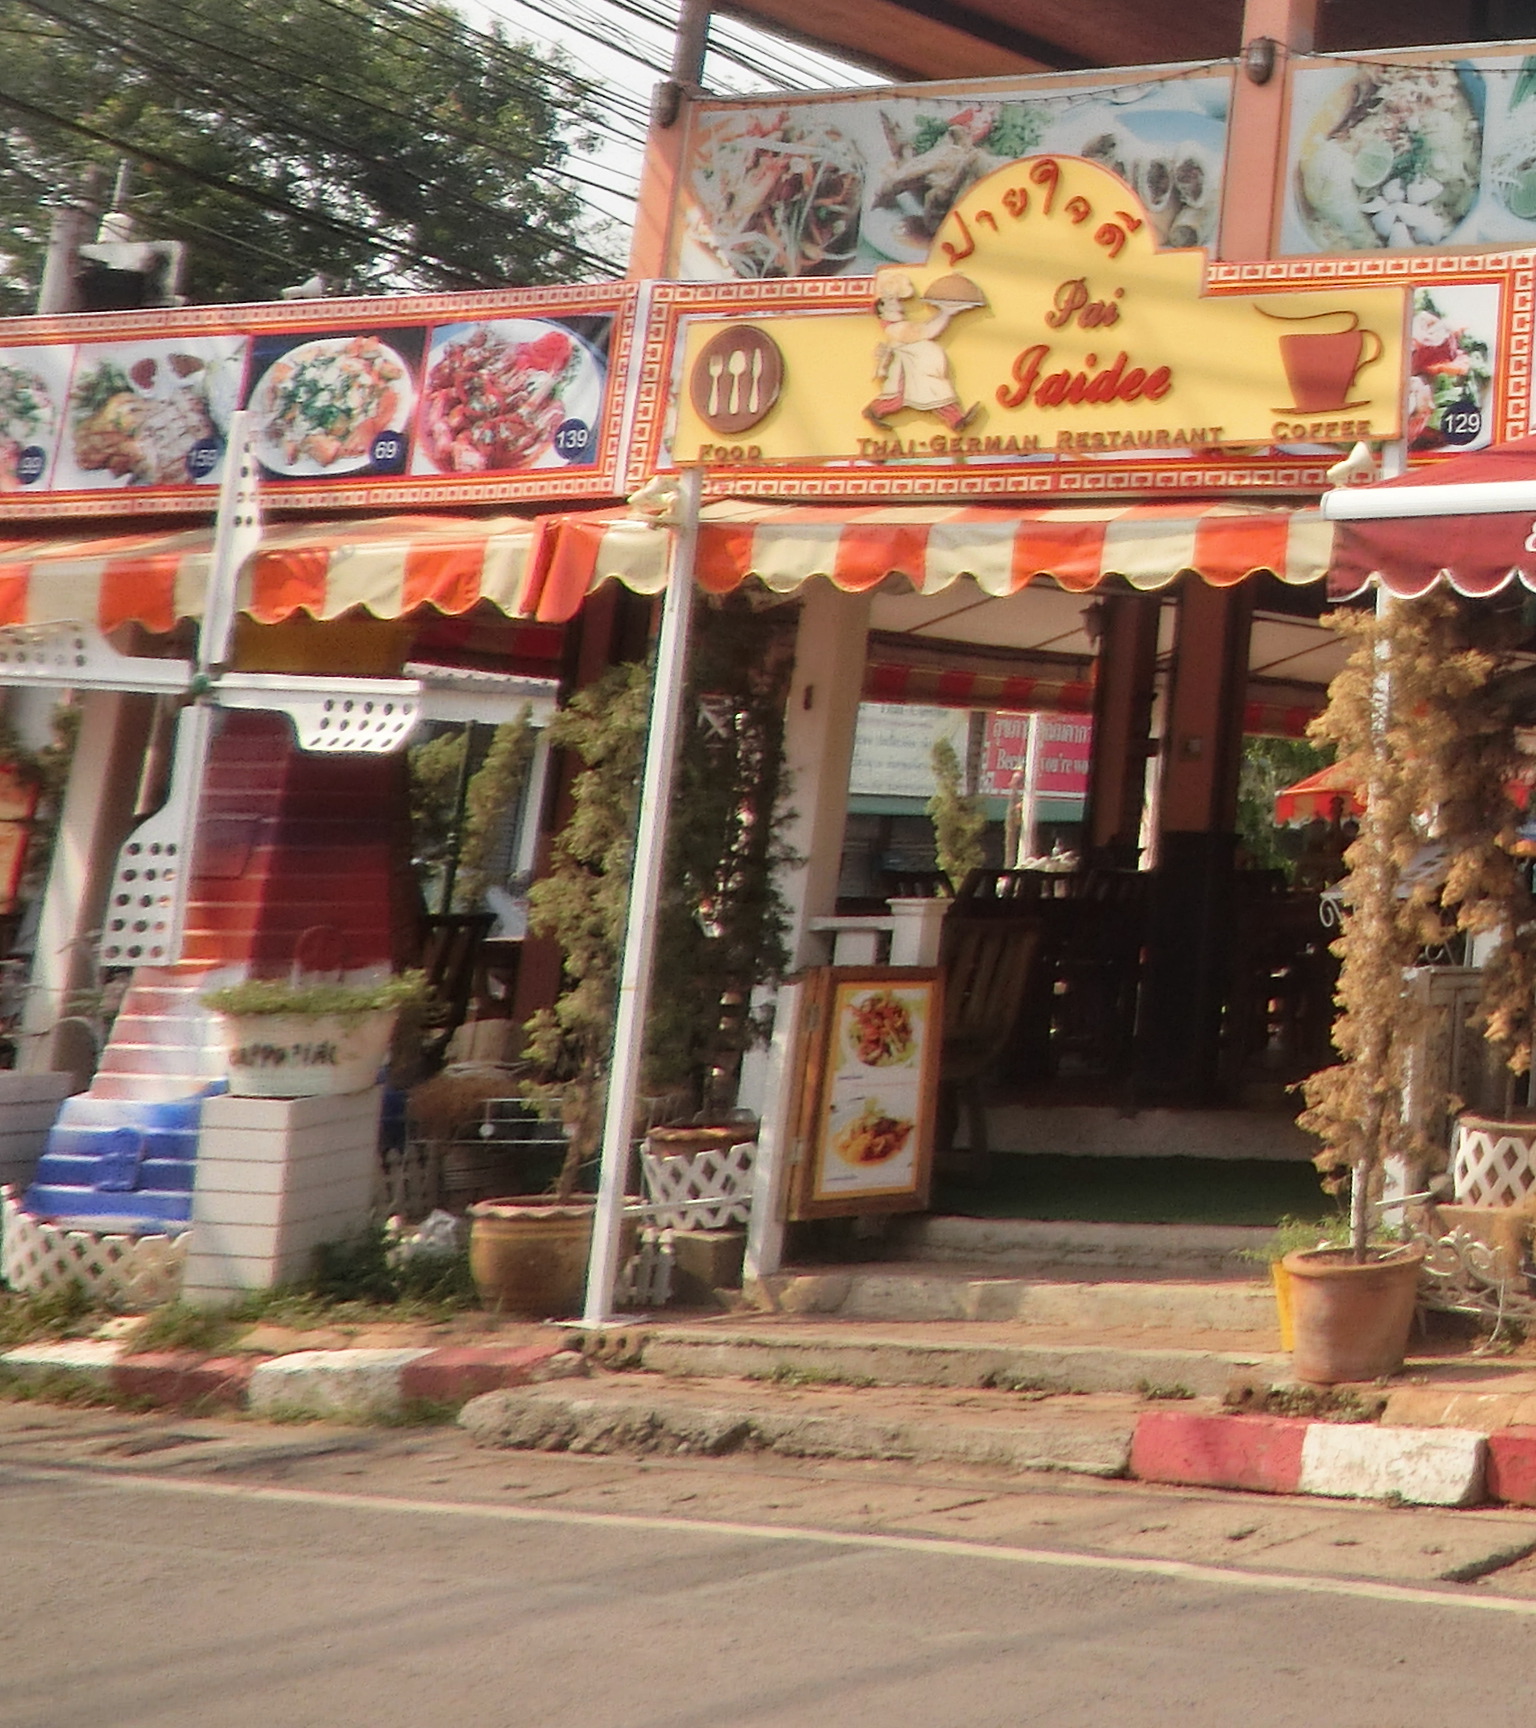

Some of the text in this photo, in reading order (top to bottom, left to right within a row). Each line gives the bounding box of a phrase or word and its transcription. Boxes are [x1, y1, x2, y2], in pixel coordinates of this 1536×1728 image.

[942, 158, 1142, 266] ปายใจดี
[1044, 276, 1125, 330] Pai
[1444, 412, 1481, 435] 129
[375, 440, 398, 460] 69
[556, 429, 588, 450] 139
